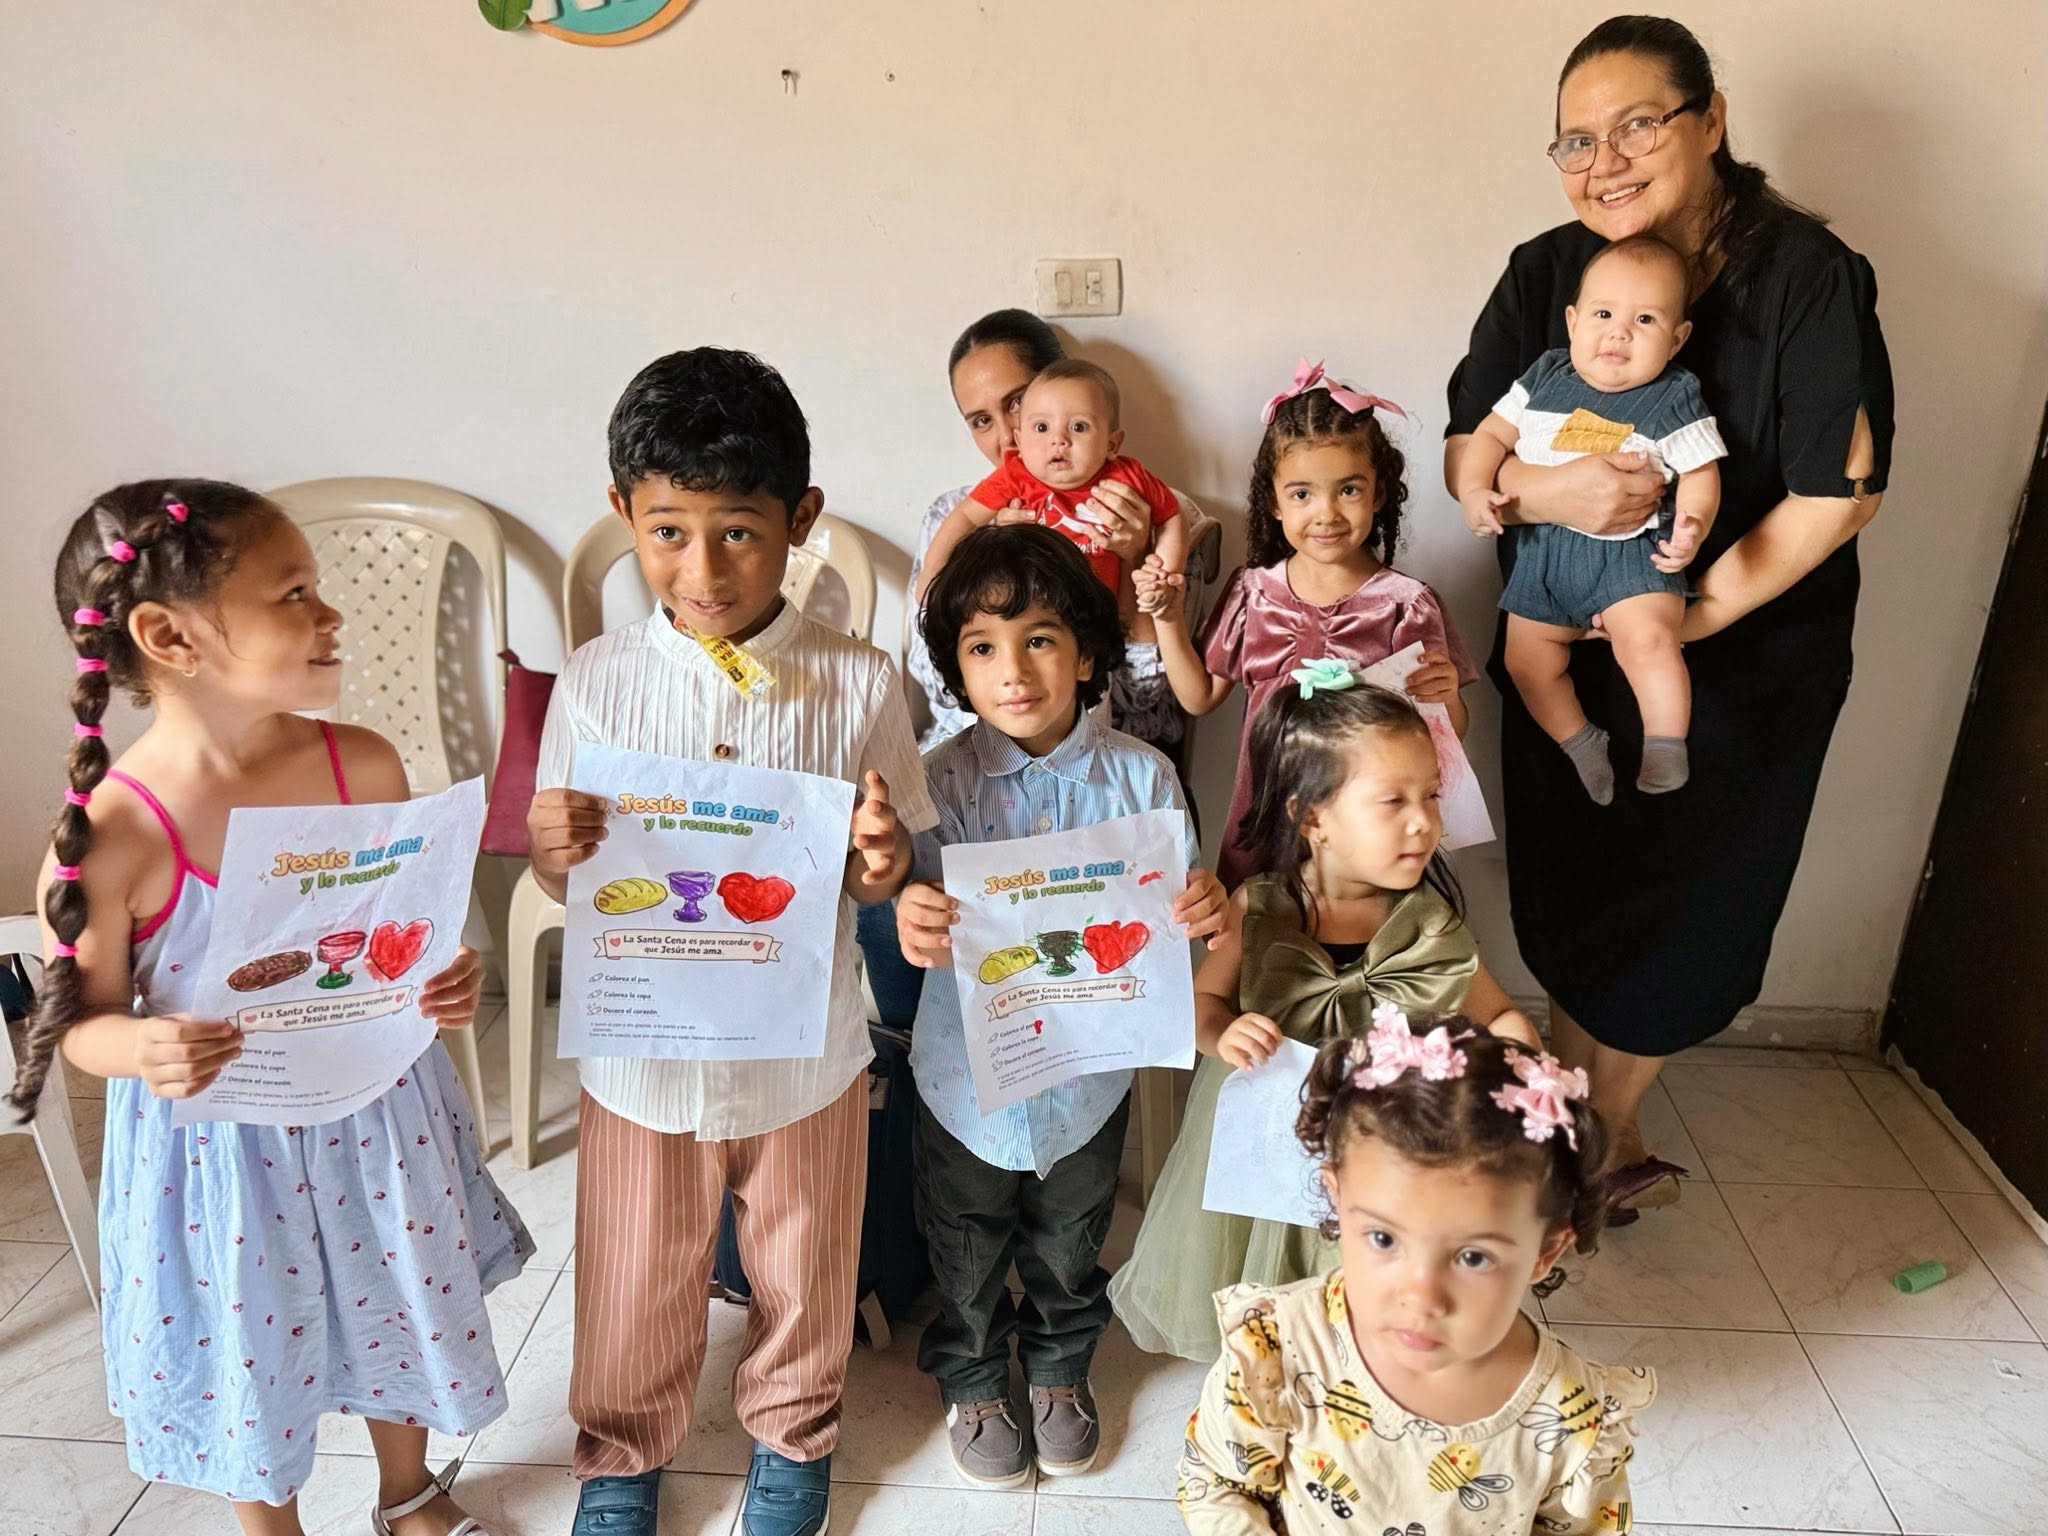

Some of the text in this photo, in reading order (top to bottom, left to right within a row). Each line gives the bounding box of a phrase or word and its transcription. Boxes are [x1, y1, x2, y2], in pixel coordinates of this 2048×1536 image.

[616, 792, 780, 824] Jesús me ama
[643, 815, 753, 836] y lo recuerdo
[270, 836, 424, 878] Jesús me ama
[299, 860, 401, 895] y lo recuerdo
[984, 860, 1125, 894] Jesús me ama
[1009, 879, 1105, 905] y lo recuerdo
[623, 935, 634, 943] La
[637, 936, 662, 944] Santa
[664, 936, 686, 945] Cena
[718, 938, 751, 946] recordar
[661, 945, 685, 954] Jesús
[1008, 994, 1017, 1002] La
[1018, 989, 1040, 998] Santa
[1088, 983, 1117, 991] recordar
[1026, 996, 1038, 1004] que
[1040, 993, 1061, 1001] Jesús
[261, 1010, 273, 1019] La
[276, 1007, 303, 1018] Santa
[306, 1004, 330, 1016] Cena
[342, 1001, 360, 1011] para
[362, 994, 393, 1007] recordar
[283, 1019, 299, 1028] que
[301, 1013, 327, 1024] Jesús
[330, 1012, 344, 1020] me
